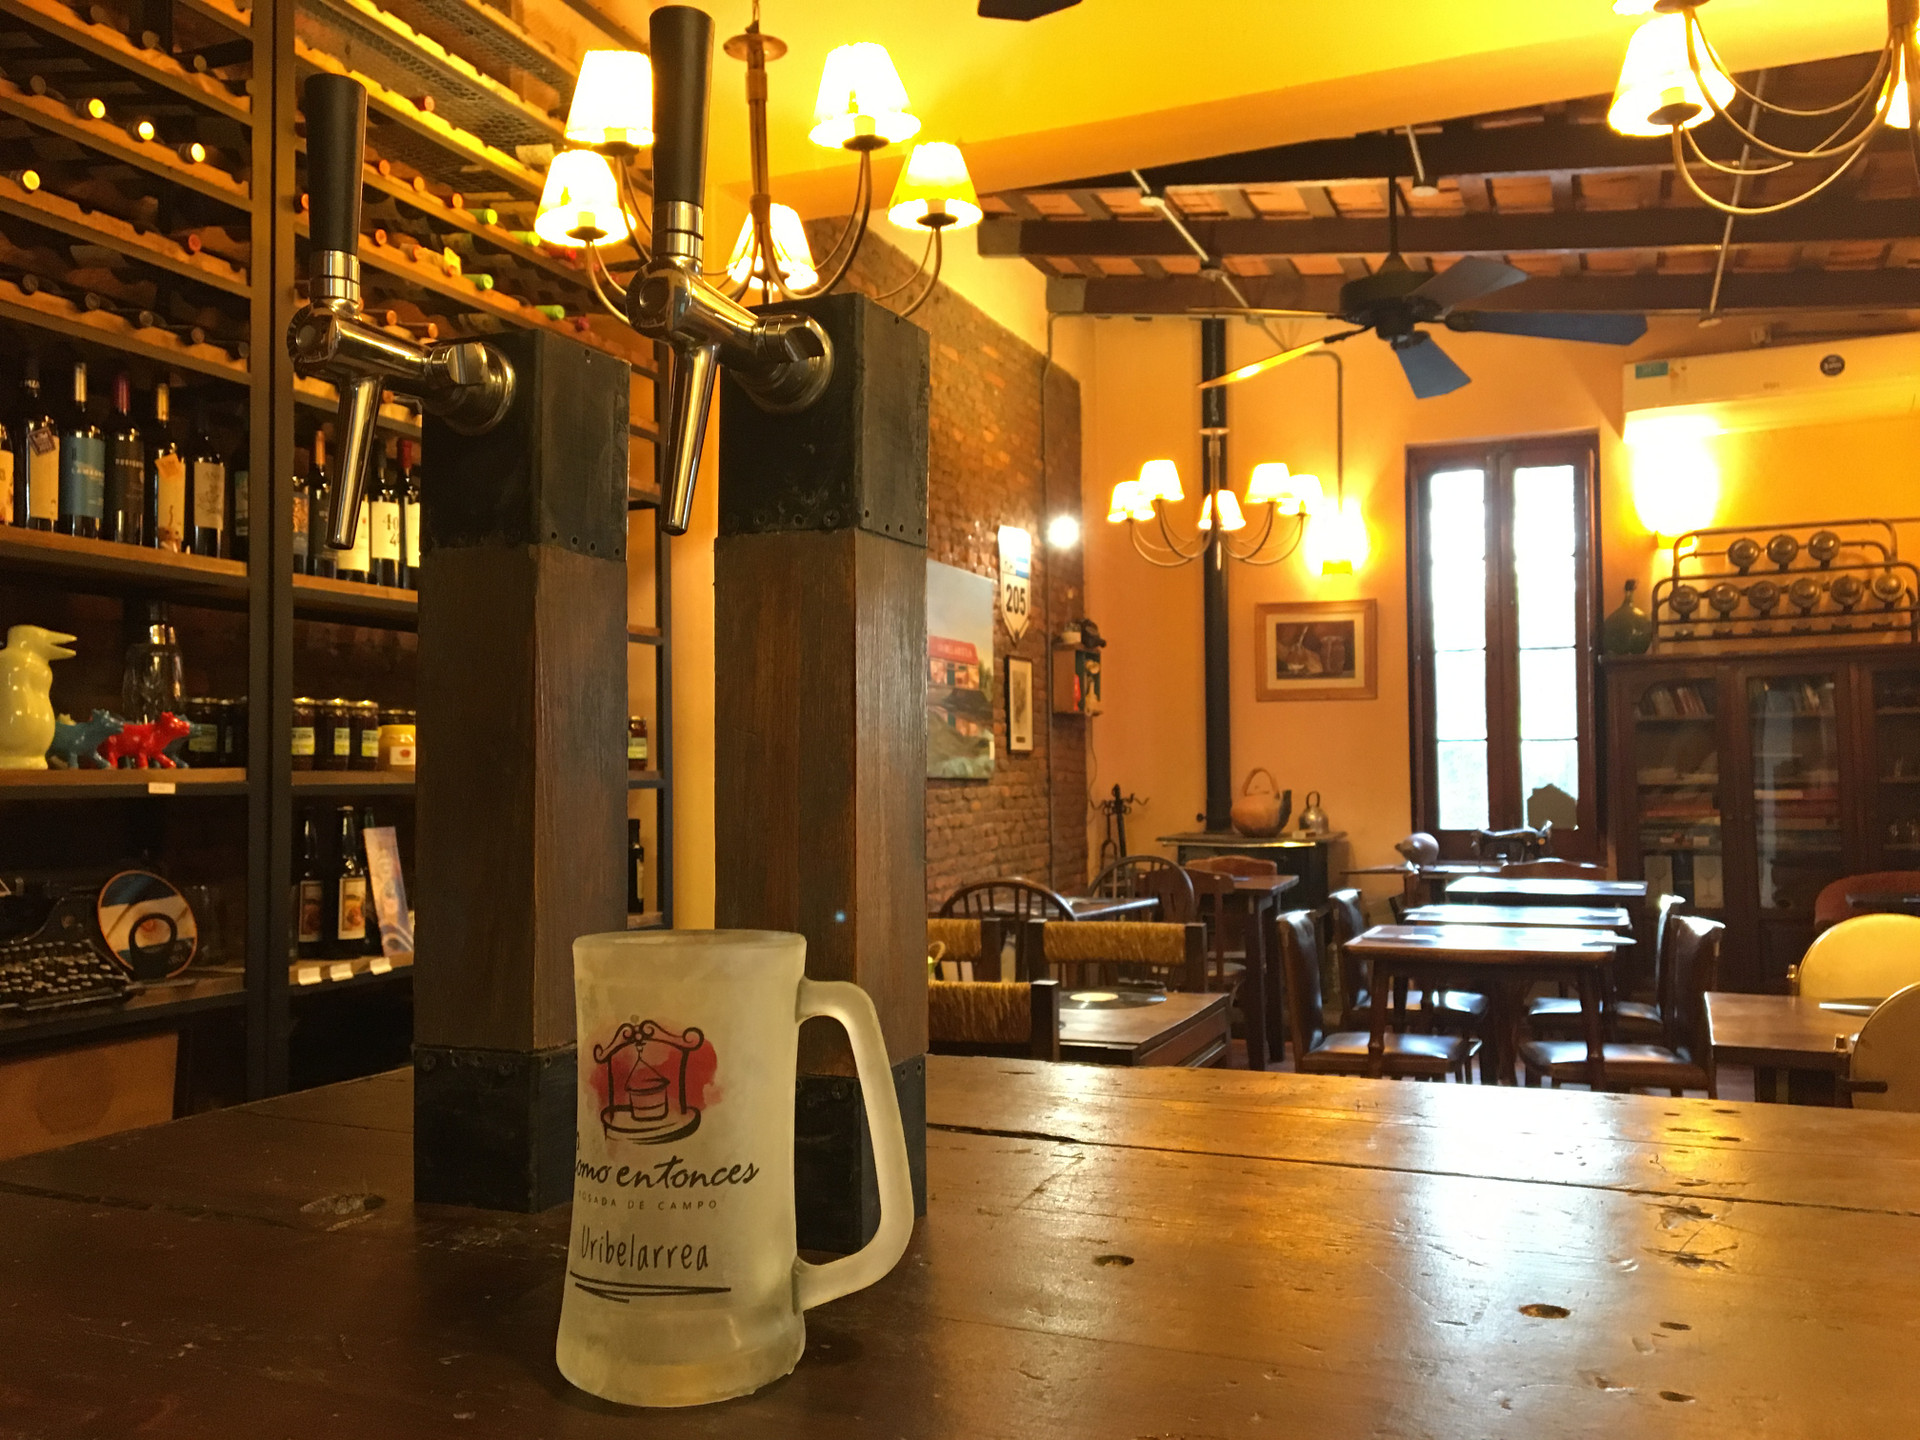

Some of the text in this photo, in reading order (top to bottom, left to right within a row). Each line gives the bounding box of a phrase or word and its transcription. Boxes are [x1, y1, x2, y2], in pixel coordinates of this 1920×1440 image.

[1006, 583, 1026, 616] 205
[616, 1155, 760, 1189] entonces
[627, 1200, 645, 1210] DE
[657, 1200, 717, 1211] CAMPO
[581, 1224, 709, 1271] Uribelarrea
